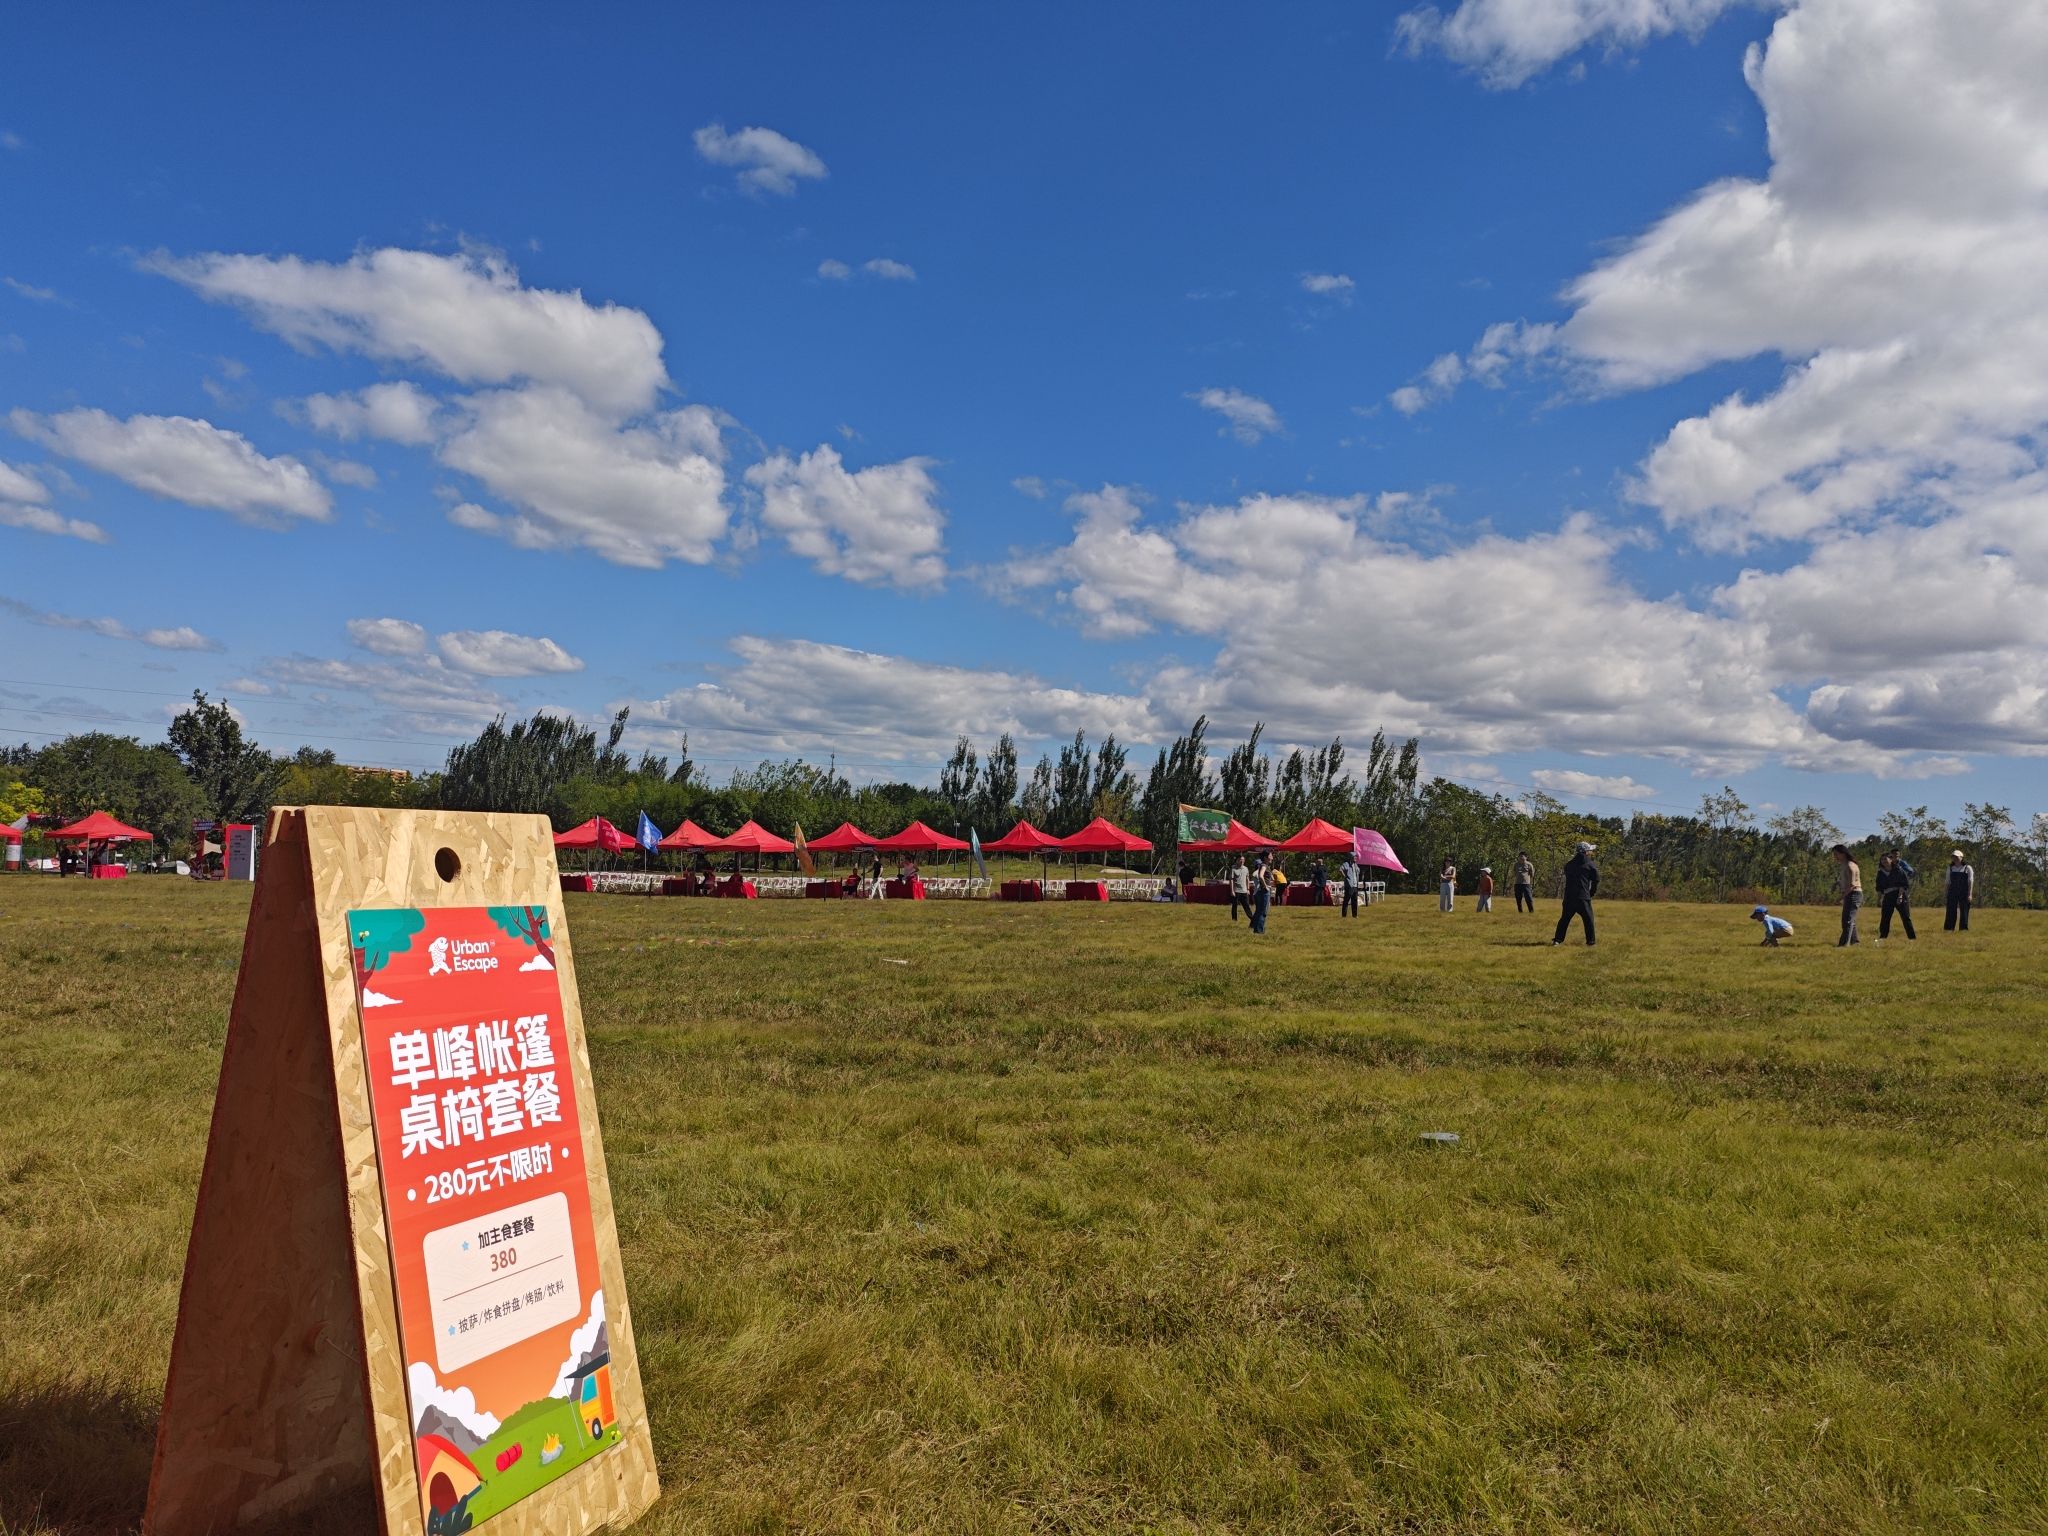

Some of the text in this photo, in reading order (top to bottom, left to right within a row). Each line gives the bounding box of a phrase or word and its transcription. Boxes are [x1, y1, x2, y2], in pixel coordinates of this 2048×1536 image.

[451, 939, 489, 955] Urban
[453, 956, 498, 973] Escape
[389, 1014, 555, 1090] 单峰帐篷
[400, 1071, 561, 1159] 桌椅套餐
[424, 1142, 552, 1203] 280元不限时
[478, 1216, 534, 1249] 加主食套餐
[490, 1247, 517, 1272] 380
